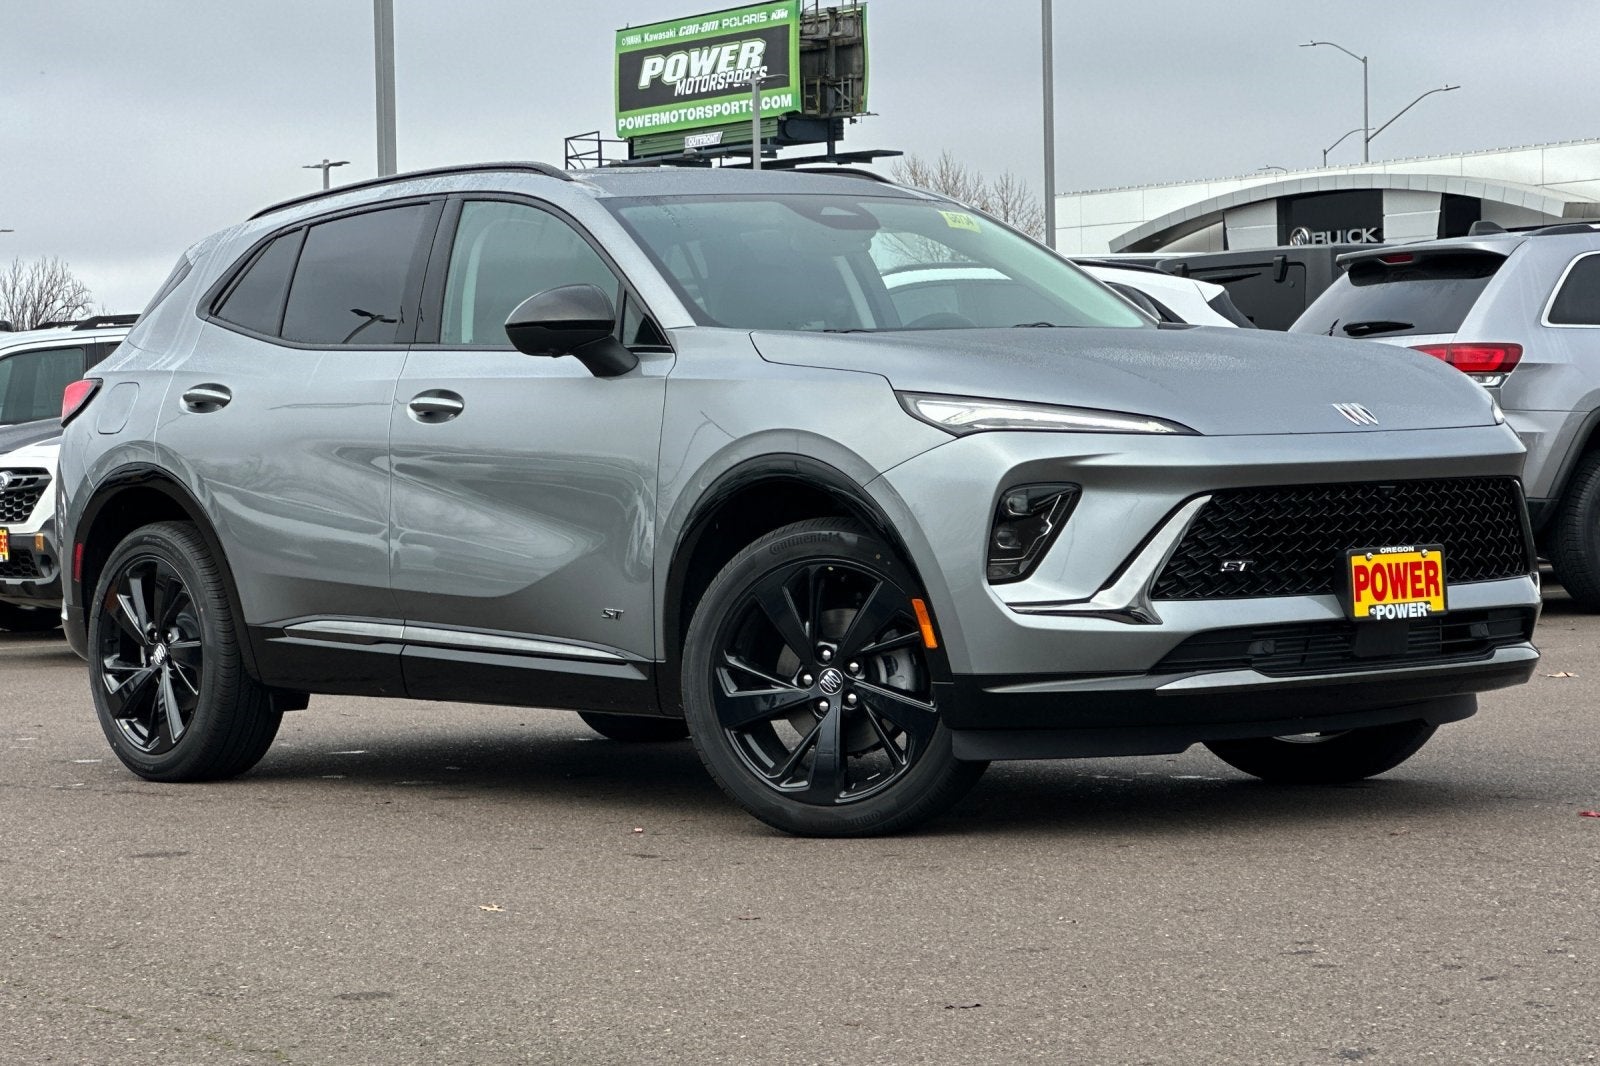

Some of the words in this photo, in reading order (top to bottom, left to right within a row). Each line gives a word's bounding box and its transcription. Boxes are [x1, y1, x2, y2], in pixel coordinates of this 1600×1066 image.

[644, 28, 676, 42] Kawasaki
[678, 20, 719, 37] can-am
[722, 12, 767, 29] POLARIS
[771, 8, 789, 21] KTM
[638, 38, 766, 89] POWER
[1311, 227, 1378, 245] BUICK
[1380, 546, 1415, 554] OREGON
[1221, 560, 1254, 571] ST
[1353, 560, 1441, 603] POWER
[601, 607, 624, 620] ST
[1376, 601, 1428, 620] POWER
